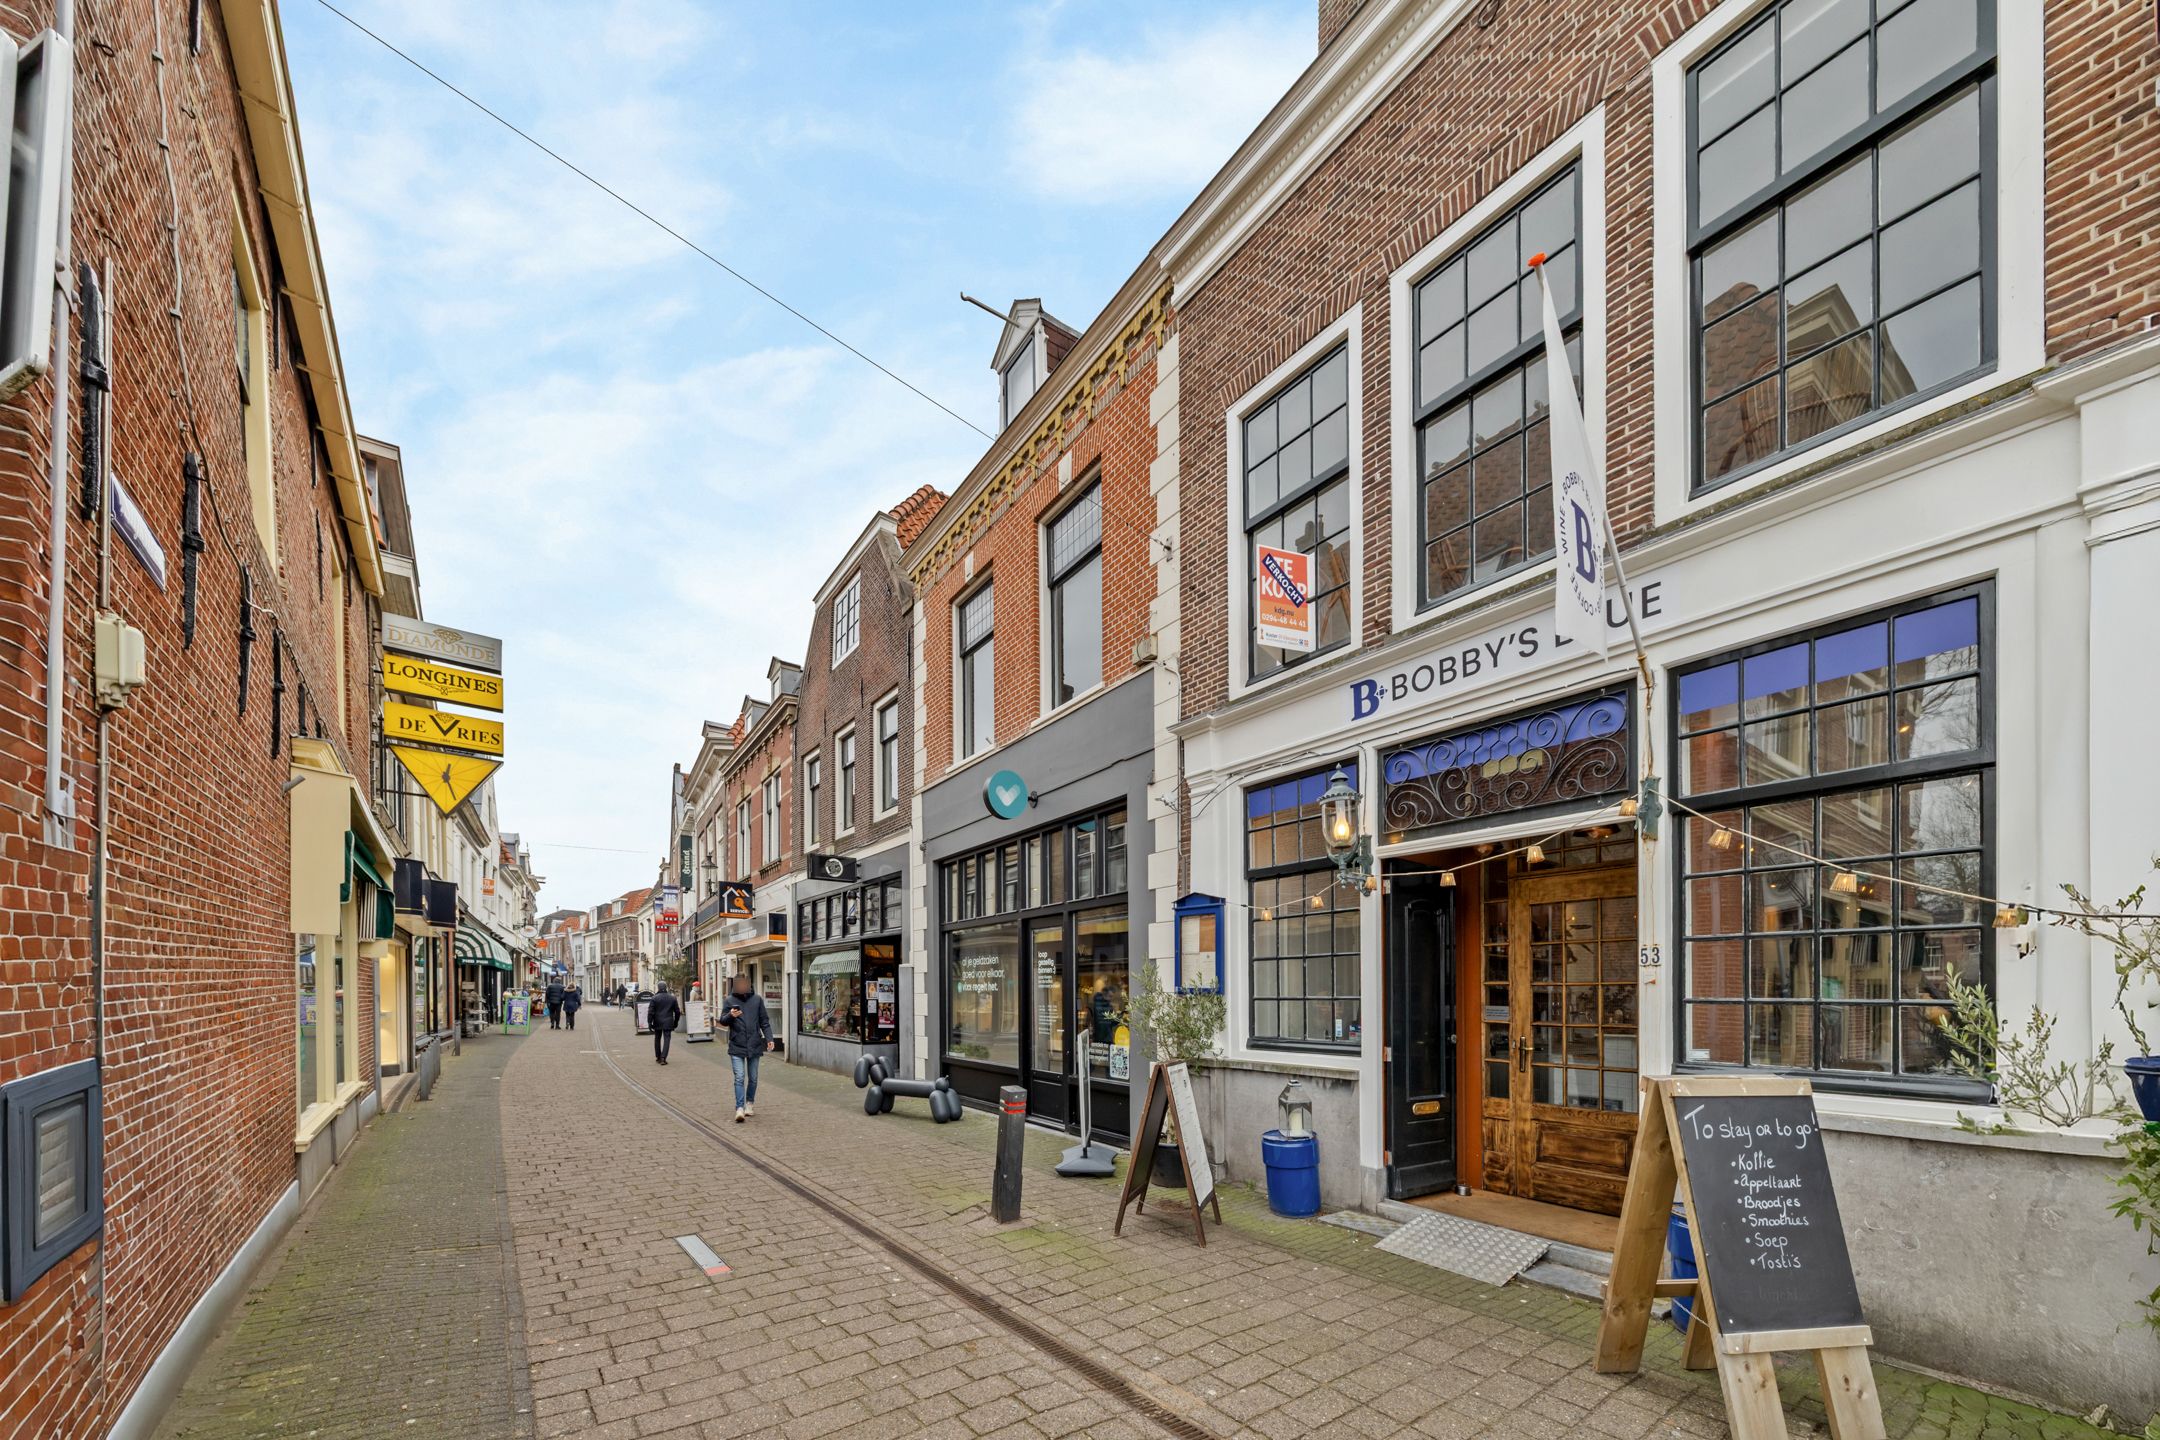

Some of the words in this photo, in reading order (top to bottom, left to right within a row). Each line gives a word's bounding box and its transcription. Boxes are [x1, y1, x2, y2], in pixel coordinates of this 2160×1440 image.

[1559, 506, 1568, 554] WINE
[1261, 575, 1307, 600] KOP
[1264, 556, 1304, 605] VERKOCHT
[1570, 573, 1594, 616] COFFEE
[388, 662, 498, 694] LONGINES
[1391, 626, 1539, 701] BOBBY'S
[400, 717, 426, 733] DE
[429, 714, 500, 745] VRIES
[1641, 947, 1660, 964] 53
[1684, 1104, 1714, 1140] To
[1720, 1117, 1753, 1148] stay
[1775, 1118, 1792, 1136] to
[1754, 1232, 1788, 1255] Soep
